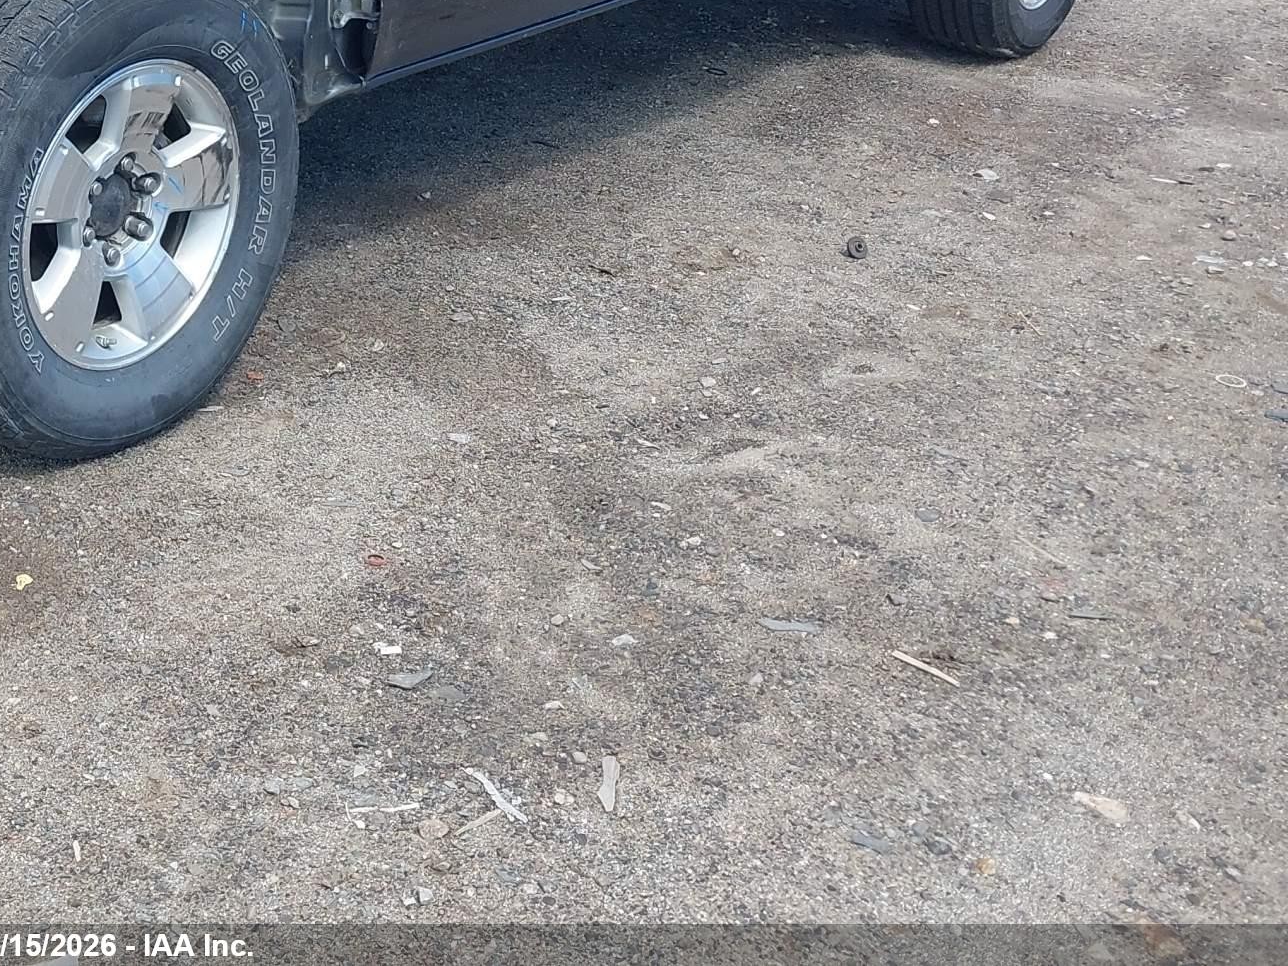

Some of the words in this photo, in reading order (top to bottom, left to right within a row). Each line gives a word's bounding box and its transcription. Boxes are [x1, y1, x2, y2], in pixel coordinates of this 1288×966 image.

[211, 40, 276, 256] GEOLANDAR
[8, 147, 45, 374] YOKOHAMA
[211, 268, 254, 341] H/T
